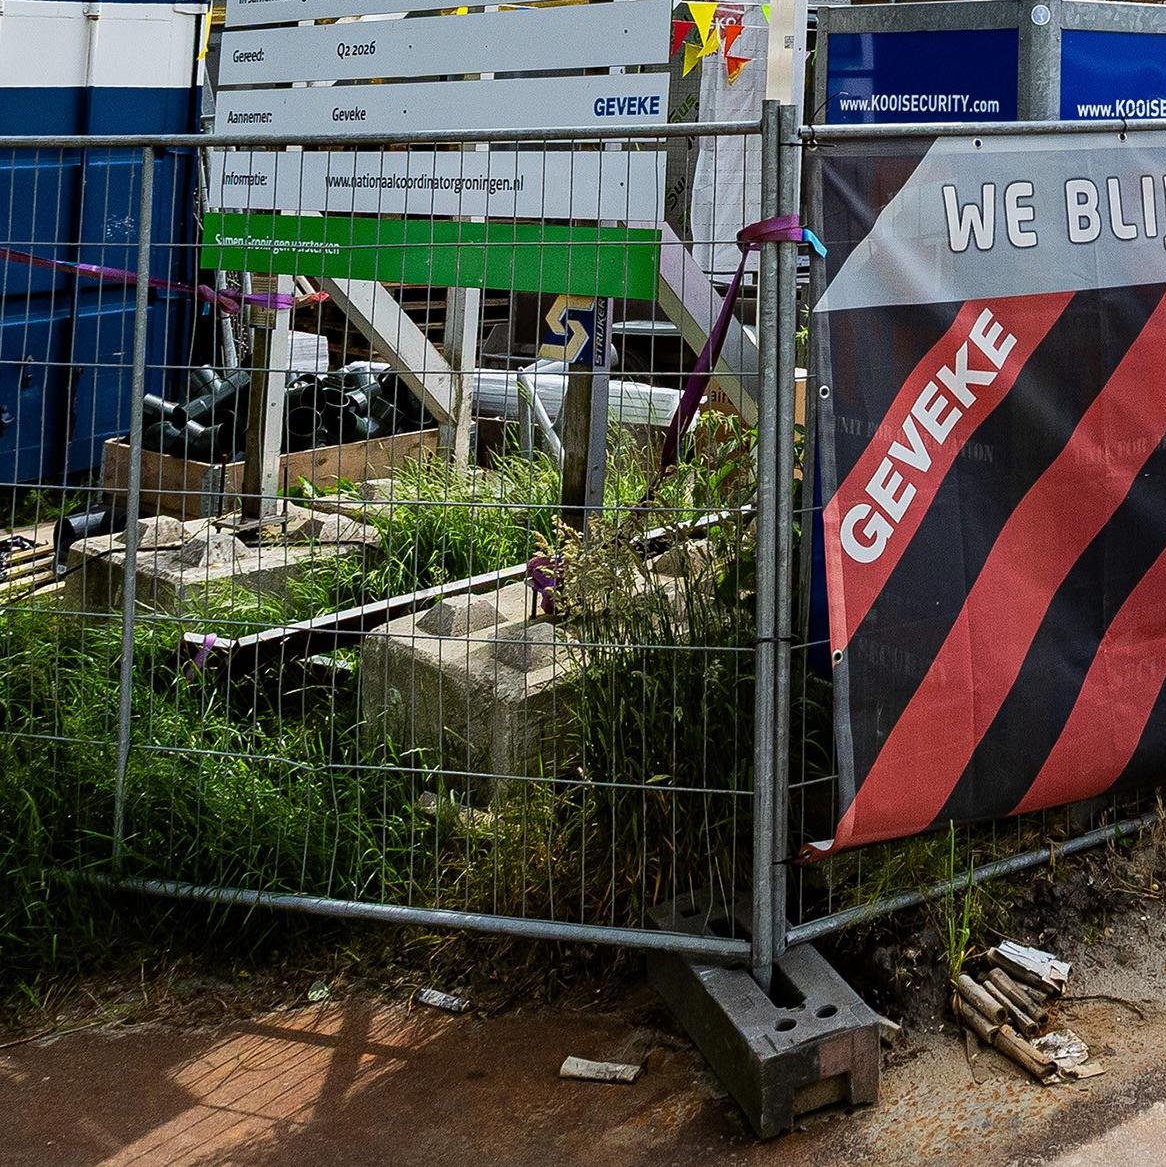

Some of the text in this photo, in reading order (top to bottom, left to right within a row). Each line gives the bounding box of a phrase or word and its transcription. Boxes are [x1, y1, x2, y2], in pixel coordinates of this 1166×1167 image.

[233, 40, 376, 63] Gereed: Q2 2026
[227, 96, 660, 124] Aannemer: Geveke GEVEKE
[942, 180, 1038, 253] WE
[839, 307, 1018, 564] GEVEKE
